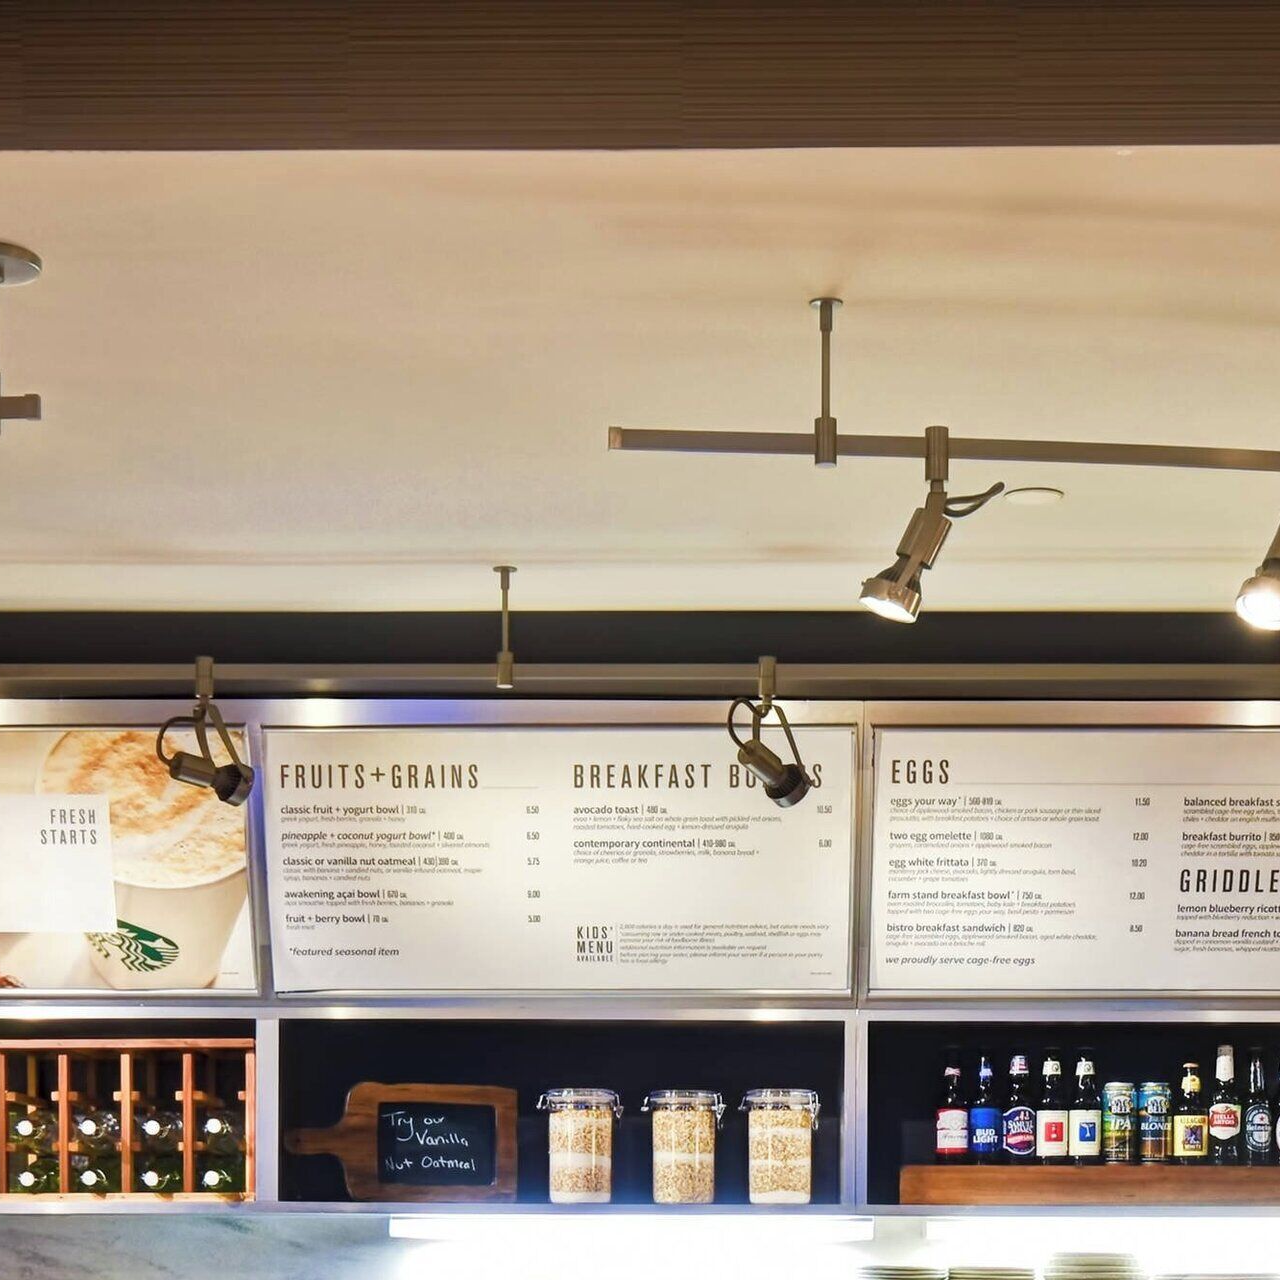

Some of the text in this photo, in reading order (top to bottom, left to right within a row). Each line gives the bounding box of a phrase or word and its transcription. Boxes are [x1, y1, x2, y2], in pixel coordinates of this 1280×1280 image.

[574, 763, 823, 789] BREAKFAST BOS
[892, 760, 949, 784] EGGS
[890, 798, 912, 808] eggs
[913, 799, 935, 810] your
[1184, 797, 1226, 806] balanced
[1229, 797, 1273, 806] breakfast
[281, 805, 399, 816] classic fruit yogurt bowl
[574, 805, 612, 814] avocado
[615, 806, 638, 814] toast
[50, 808, 96, 825] FRESH
[40, 829, 97, 845] STARTS
[282, 831, 327, 843] pineapple
[337, 832, 373, 840] coconut
[376, 832, 406, 842] yogurt
[890, 832, 908, 840] two
[910, 833, 927, 842] egg
[929, 831, 971, 840] omelette
[1183, 832, 1261, 841] breakfast burrito
[574, 839, 695, 850] contemporary continental
[283, 857, 312, 865] classic
[327, 857, 357, 865] vanilla
[378, 857, 416, 865] oatmeal
[889, 857, 969, 870] egg white frittata
[285, 890, 335, 900] awakening
[357, 890, 380, 898] bowl
[888, 890, 910, 899] farm
[913, 891, 938, 899] stand
[941, 891, 985, 899] breakfast
[1178, 904, 1207, 912] lemon
[1208, 904, 1255, 916] blueberry
[286, 914, 365, 925] fruit berry bowl
[887, 923, 1005, 932] bistro breakfast sandwich
[1176, 929, 1210, 937] banana
[1212, 929, 1239, 937] bread
[1242, 929, 1271, 938] french
[335, 947, 376, 956] seasonal
[378, 947, 399, 956] item
[577, 941, 612, 953] MENU
[899, 956, 938, 966] proudly
[967, 956, 1011, 966] cage-free
[1013, 958, 1035, 966] eggs
[381, 1110, 414, 1141] Try
[1110, 1116, 1132, 1131] IPA
[975, 1128, 996, 1136] BUD
[415, 1129, 469, 1147] Vanilla
[972, 1135, 999, 1144] LIGHT
[385, 1155, 476, 1172] Nut Oatmeal
